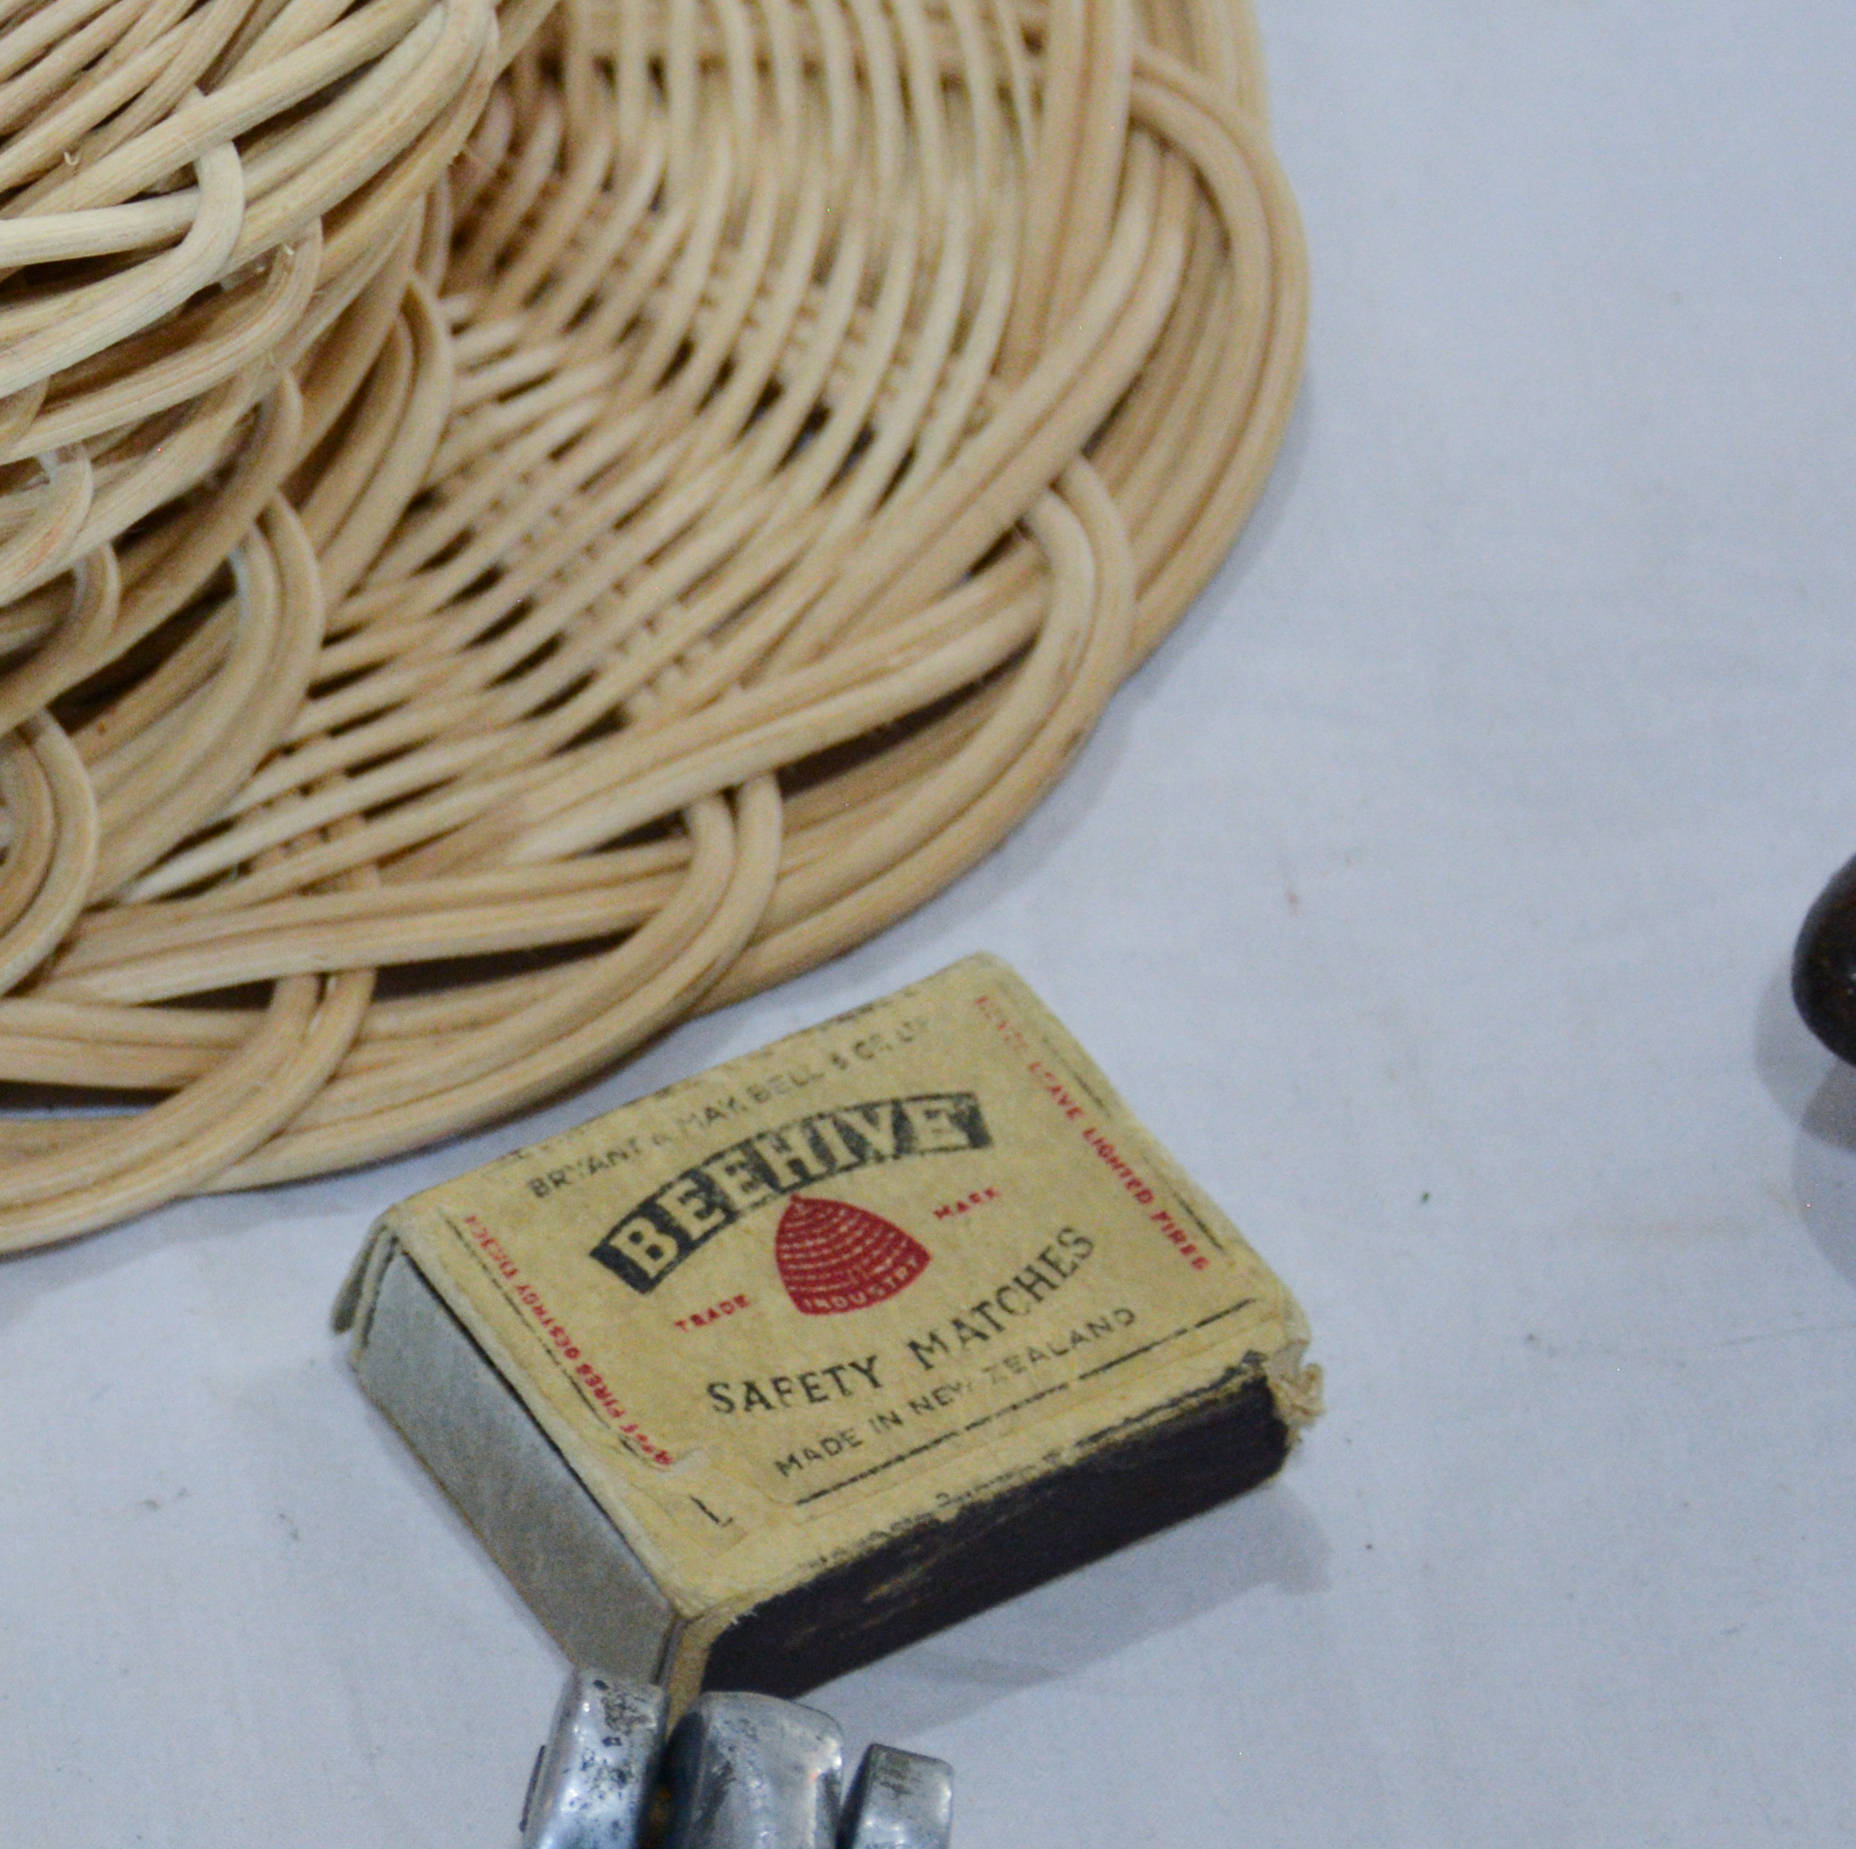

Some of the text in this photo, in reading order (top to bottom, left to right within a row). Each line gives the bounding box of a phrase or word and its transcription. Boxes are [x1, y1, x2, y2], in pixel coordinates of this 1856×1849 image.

[607, 1097, 977, 1282] BEEHIVE
[1082, 1127, 1155, 1205] LIGHTED
[515, 1283, 581, 1360] DESTROY
[674, 1186, 1002, 1333] TRADE MARK
[707, 1225, 1096, 1415] SAFETY MATCHES
[803, 1256, 921, 1310] INDUSTRY
[774, 1428, 863, 1478] MADE
[870, 1408, 904, 1434] IN
[982, 1307, 1136, 1387] ZEALAND
